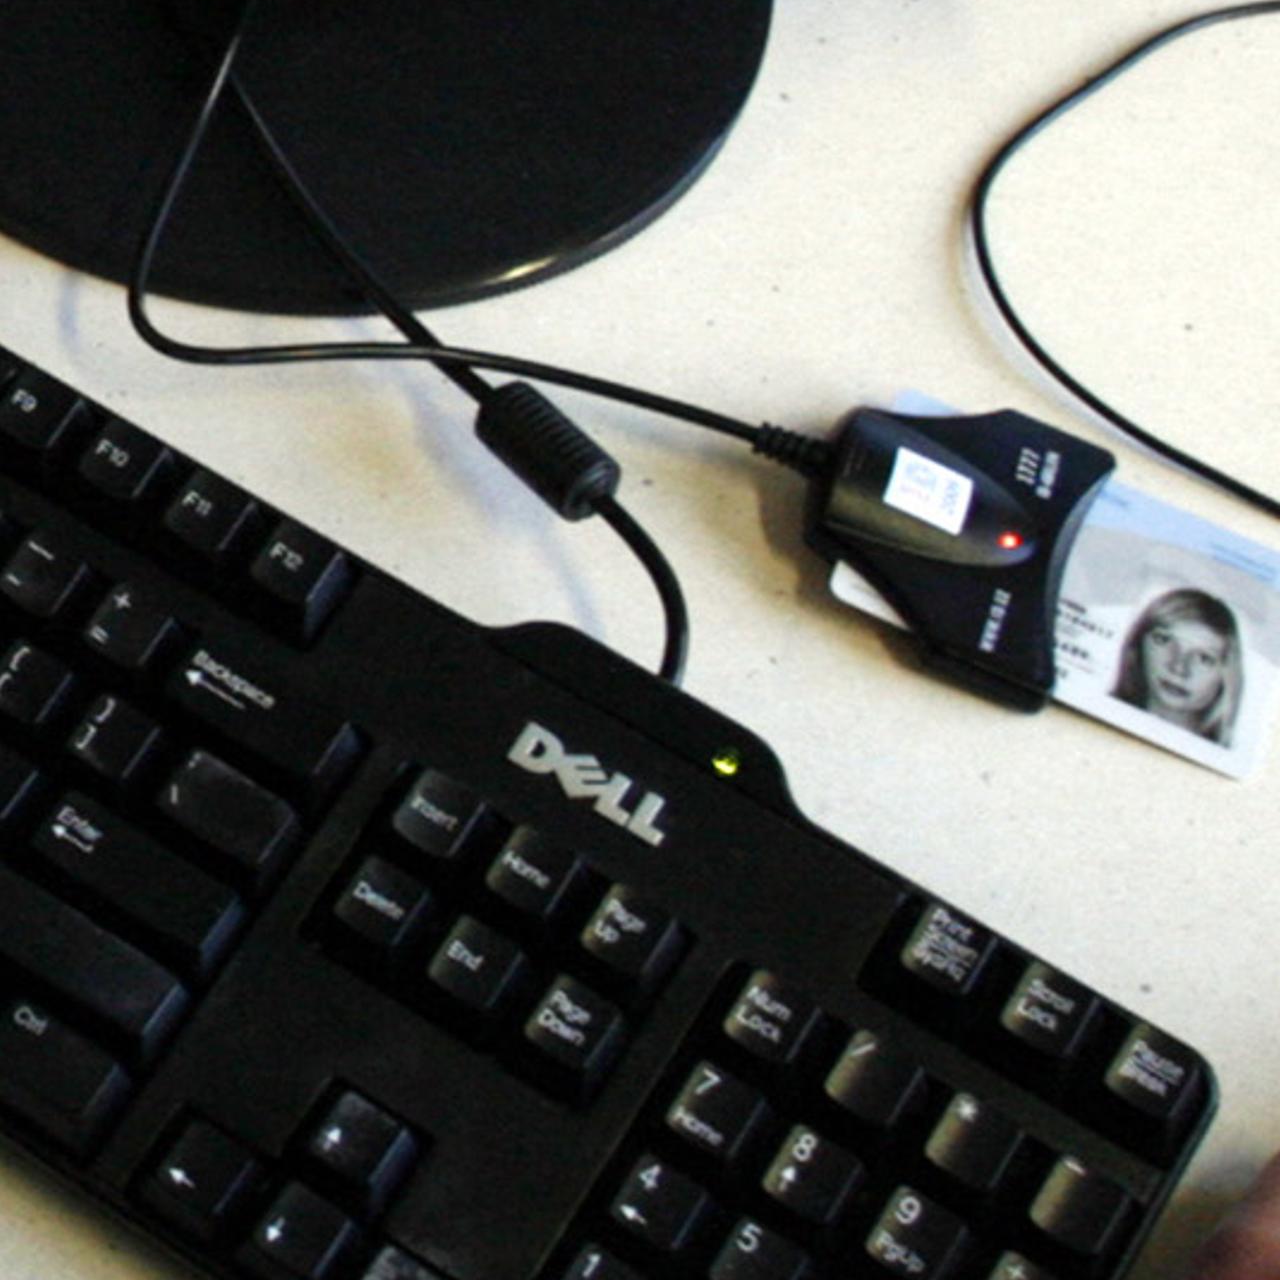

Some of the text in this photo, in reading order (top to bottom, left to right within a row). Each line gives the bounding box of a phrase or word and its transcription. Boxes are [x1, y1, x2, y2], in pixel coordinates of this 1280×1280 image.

[11, 388, 38, 413] F9
[94, 438, 131, 469] F10
[181, 489, 213, 517] F11
[268, 540, 304, 572] F12
[190, 648, 277, 711] Backspace
[506, 721, 668, 849] DELL
[409, 794, 459, 833] Insert
[501, 849, 552, 891] Home
[352, 880, 406, 920] Delete
[607, 898, 647, 936] Page
[593, 919, 621, 945] Up
[446, 939, 485, 973] End
[551, 989, 593, 1027] Page
[746, 984, 793, 1022] Num
[1027, 977, 1077, 1015] Scroll
[536, 1008, 587, 1047] Down
[735, 1006, 784, 1044] Lock
[1017, 997, 1058, 1033] Lock
[694, 1068, 722, 1095] 7
[674, 1104, 726, 1146] Home
[792, 1132, 819, 1162] 8
[638, 1163, 663, 1191] 4
[895, 1194, 923, 1225] 9
[736, 1222, 763, 1253] 5
[582, 1252, 602, 1280] 1
